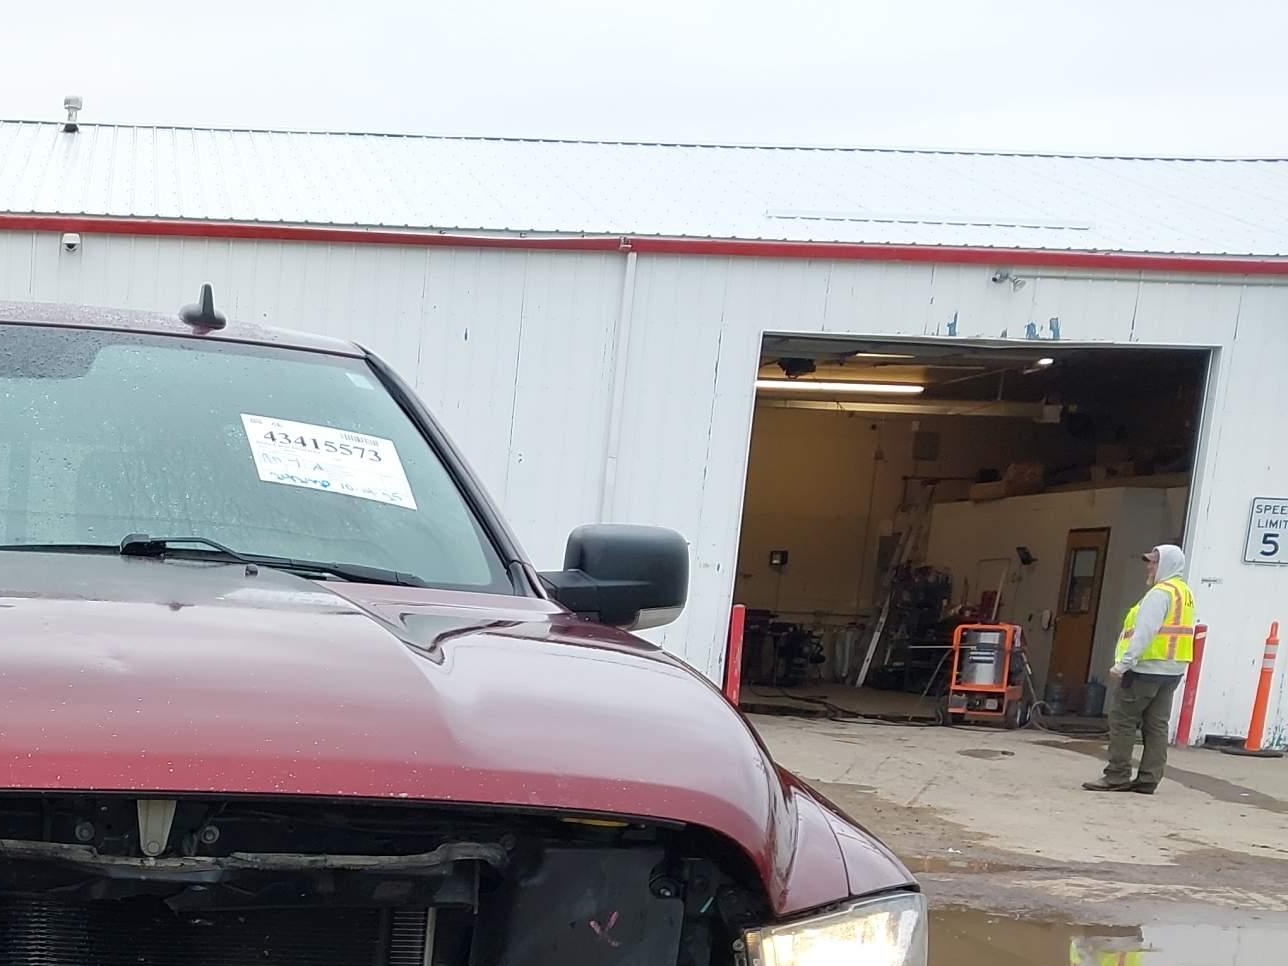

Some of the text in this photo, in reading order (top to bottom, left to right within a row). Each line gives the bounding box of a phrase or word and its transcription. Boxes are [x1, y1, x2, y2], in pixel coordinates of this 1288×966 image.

[263, 431, 382, 463] 43415573
[1257, 519, 1288, 529] LIMIT
[1259, 533, 1280, 557] 5
